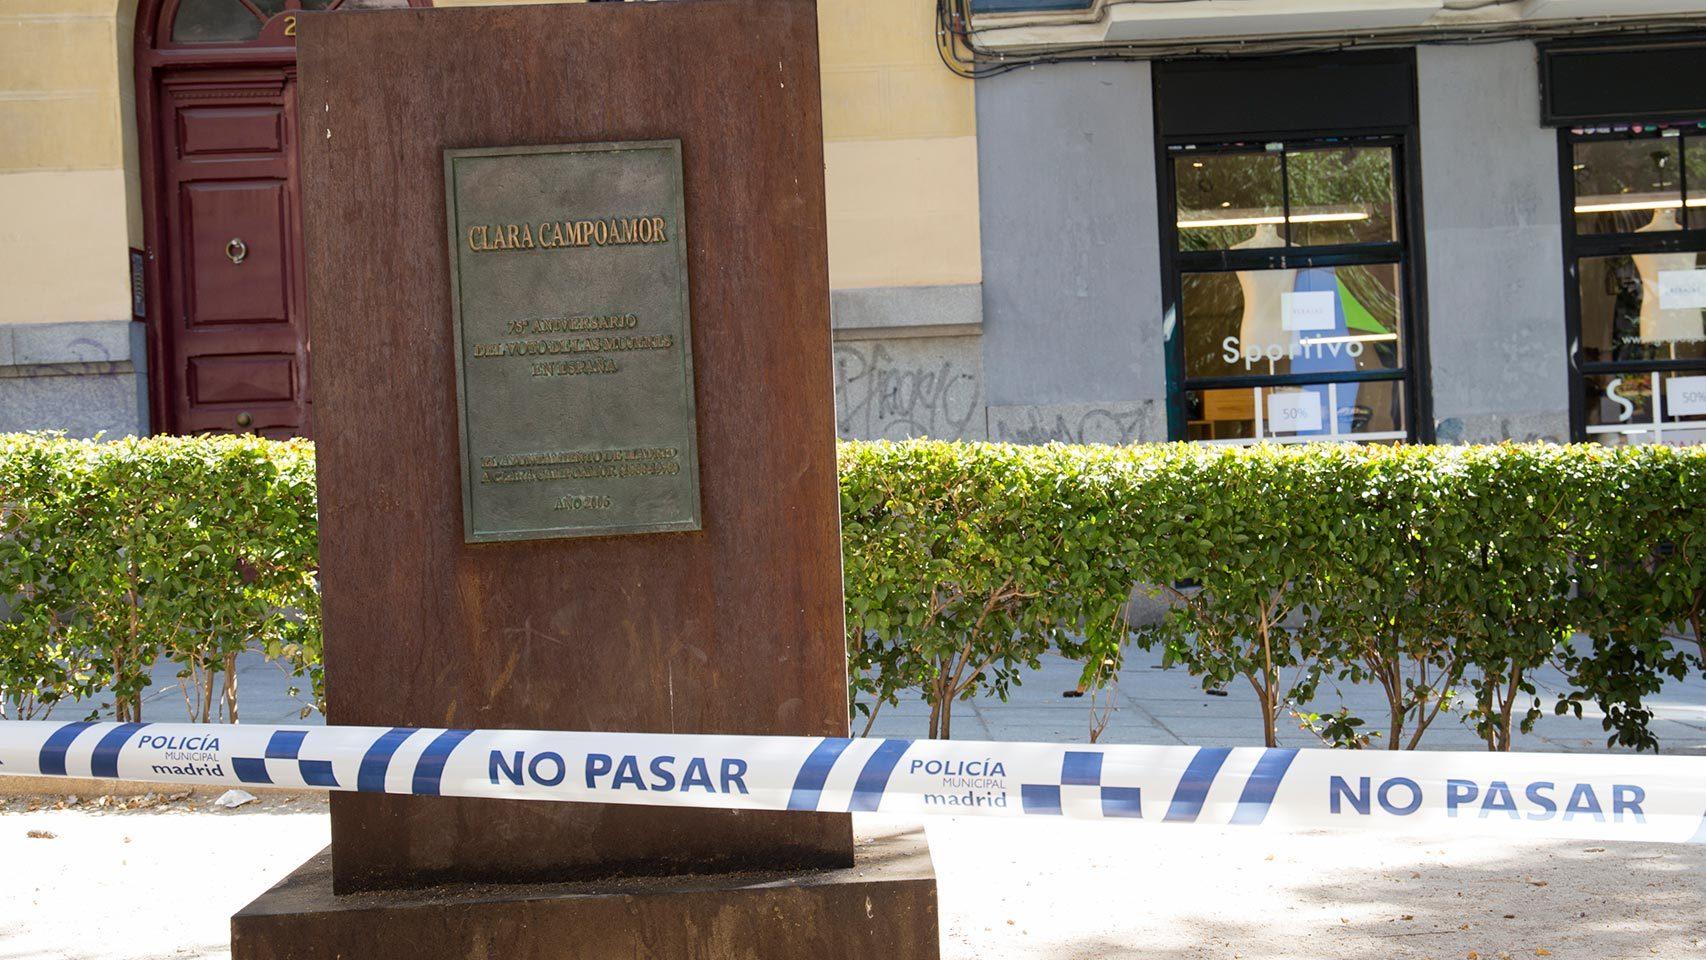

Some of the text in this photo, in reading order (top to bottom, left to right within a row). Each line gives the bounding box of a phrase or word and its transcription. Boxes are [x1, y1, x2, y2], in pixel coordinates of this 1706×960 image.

[468, 217, 667, 251] CLARA CAMPOAMOR
[531, 313, 638, 334] ANIVERSARIO
[504, 340, 547, 357] VOTO
[1222, 334, 1364, 371] Sportivo
[531, 357, 619, 377] EN ESPAÑA
[1282, 408, 1308, 420] 50%
[553, 494, 582, 511] AÑO
[138, 733, 219, 751] POLICÍA
[165, 751, 219, 762] MUNICIPAL
[151, 762, 225, 777] madrid
[488, 749, 749, 794] NO PASAR
[910, 757, 1006, 777] POLICÍA
[942, 777, 1006, 789] MUNICIPAL
[924, 790, 1007, 808] madrid
[1329, 775, 1648, 825] NO PASAR
